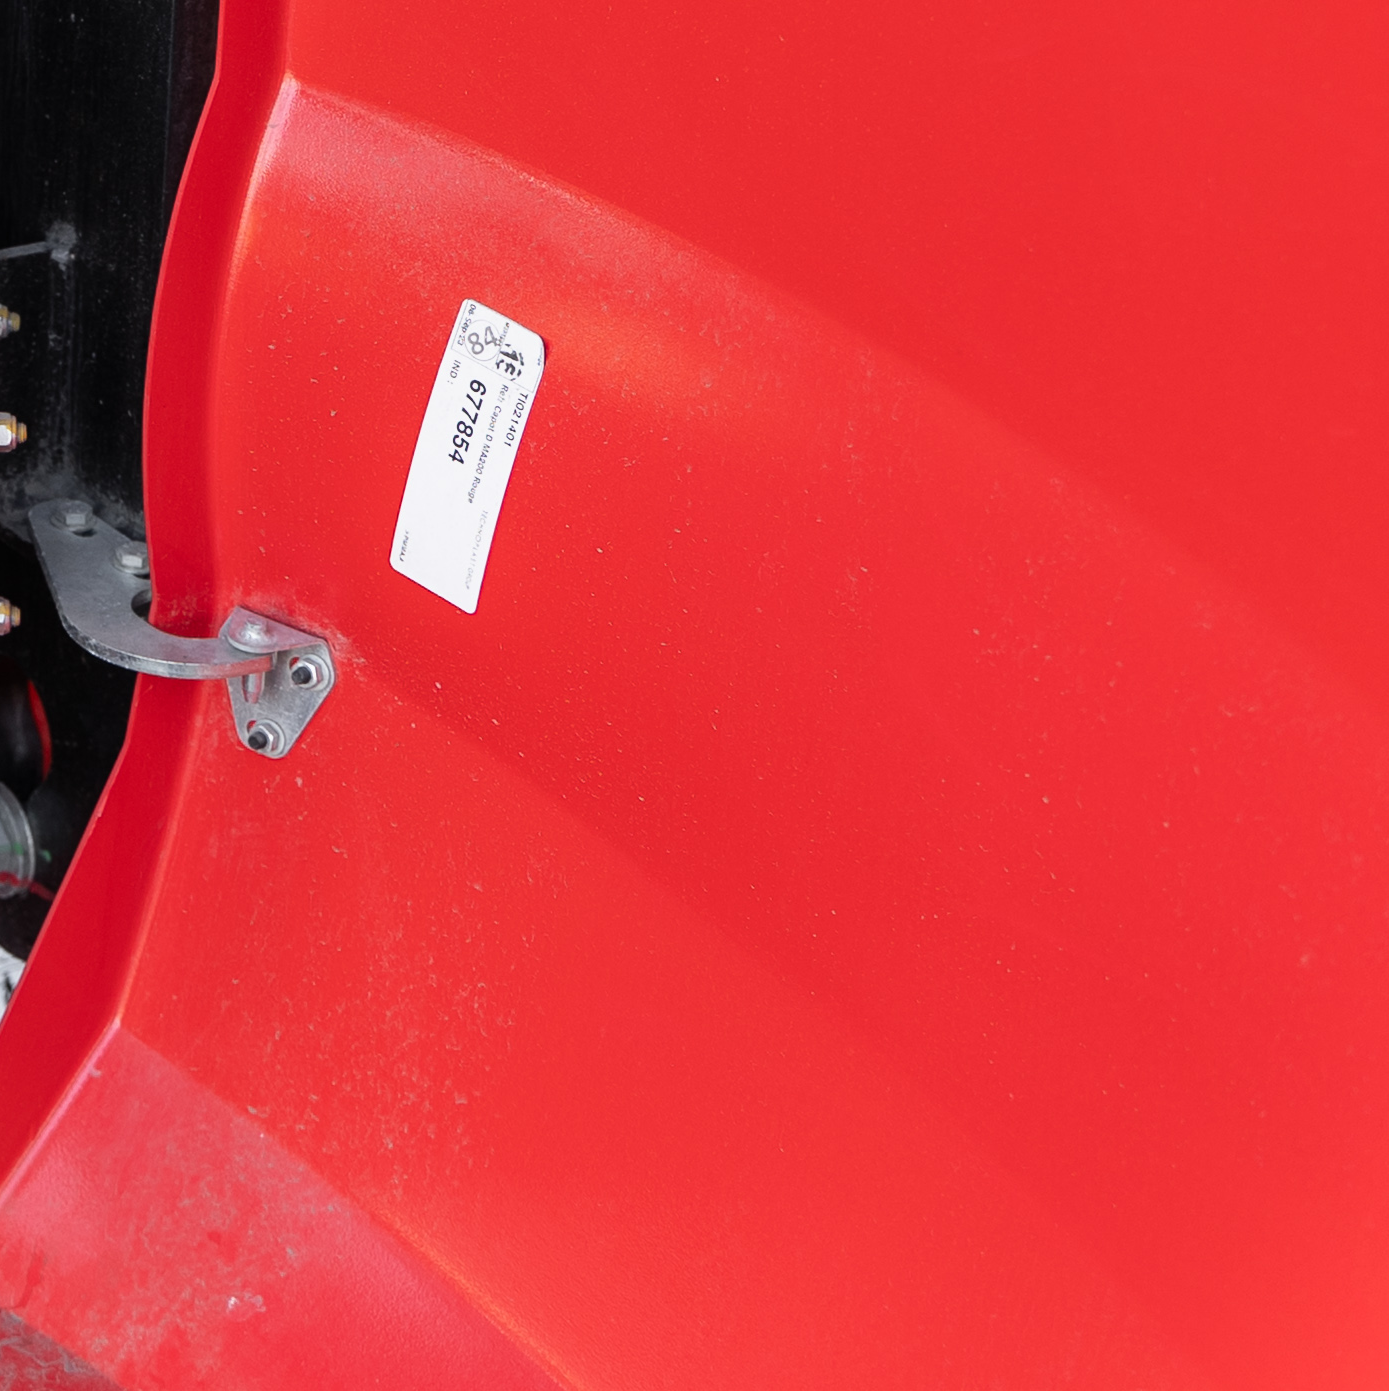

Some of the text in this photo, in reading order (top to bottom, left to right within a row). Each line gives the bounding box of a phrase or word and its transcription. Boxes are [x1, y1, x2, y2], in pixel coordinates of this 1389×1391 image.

[449, 360, 461, 379] IND
[448, 380, 487, 465] 677854
[489, 405, 502, 433] Capot
[475, 443, 491, 475] MA200
[467, 477, 481, 504] Rouge
